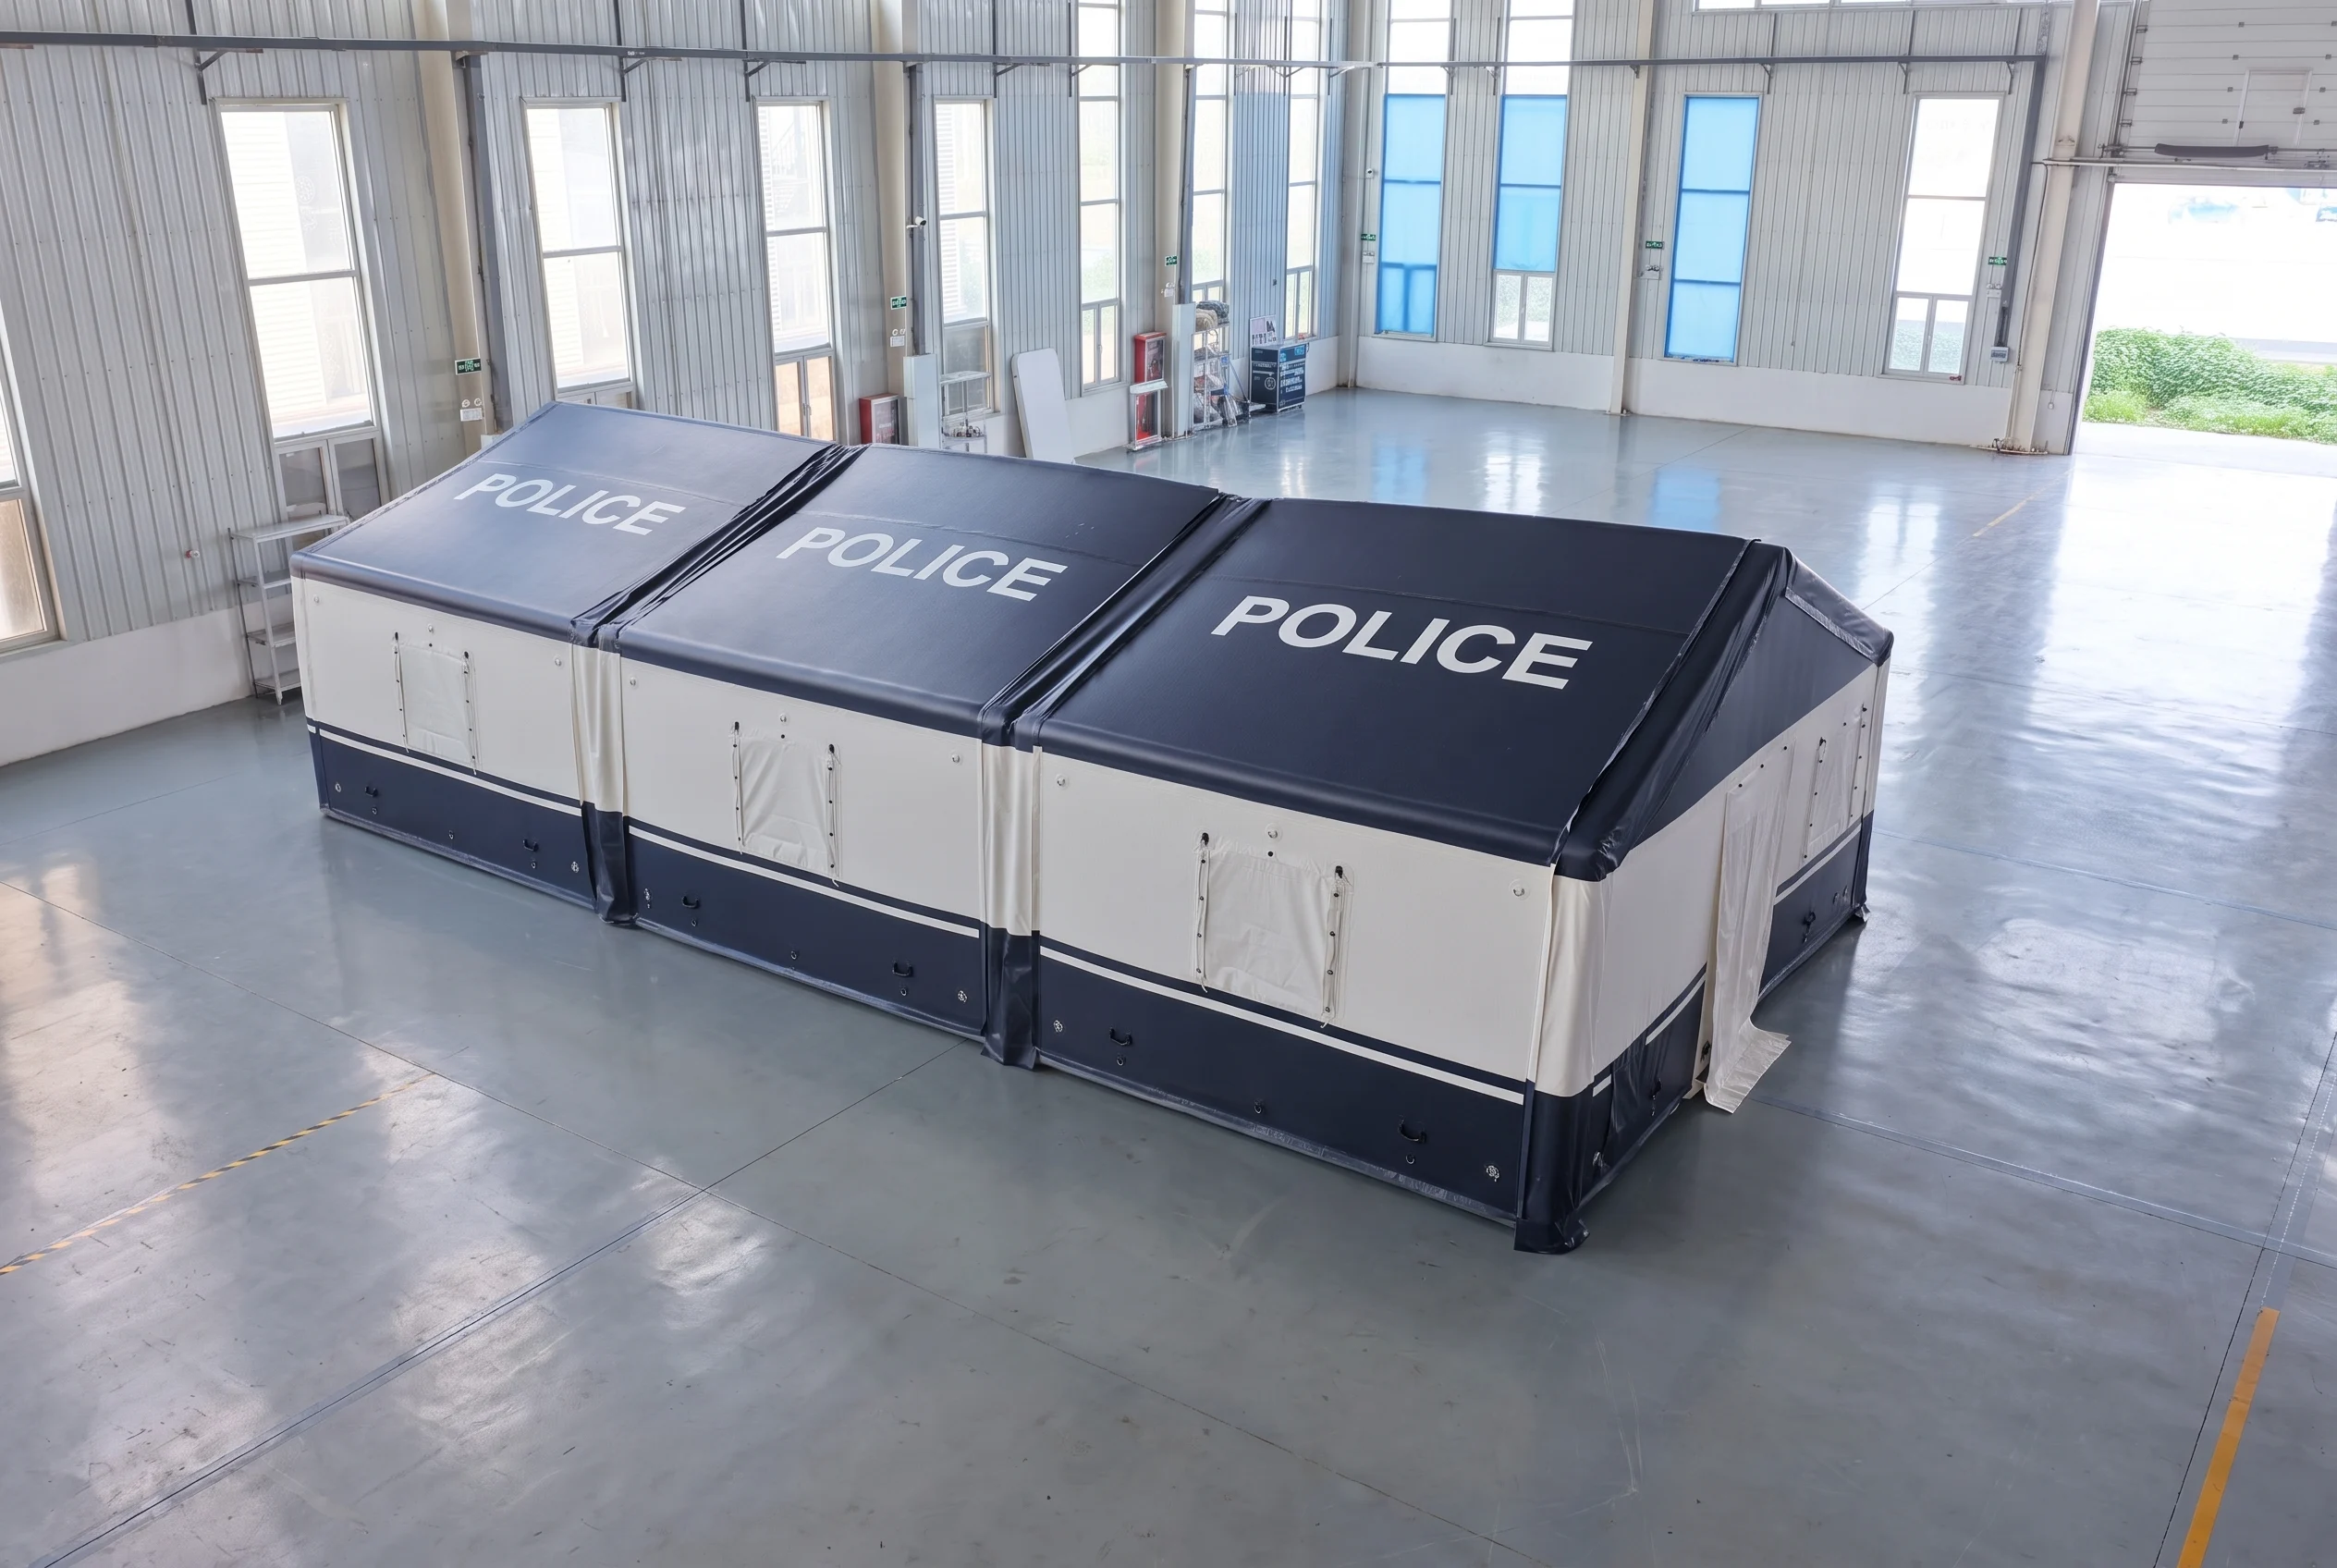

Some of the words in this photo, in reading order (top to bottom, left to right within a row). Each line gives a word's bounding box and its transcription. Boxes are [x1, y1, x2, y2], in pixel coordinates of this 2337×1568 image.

[454, 472, 686, 535] POLICE
[776, 524, 1069, 602] POLICE
[1210, 594, 1593, 690] POLICE
